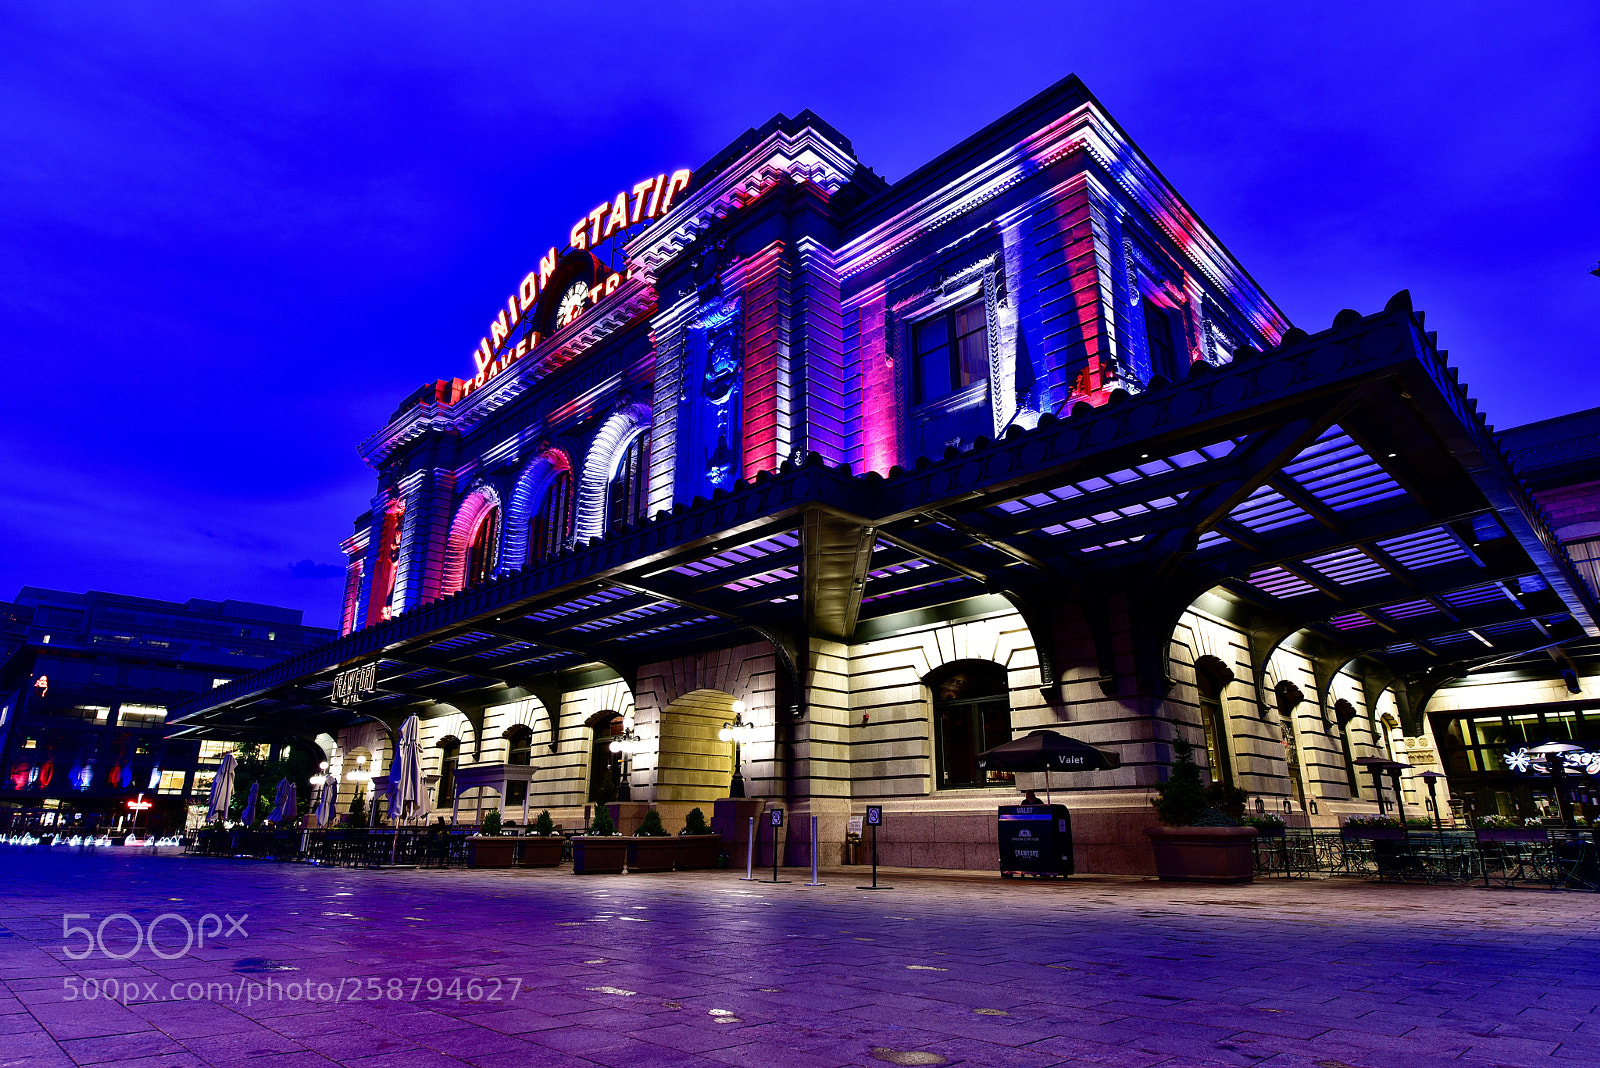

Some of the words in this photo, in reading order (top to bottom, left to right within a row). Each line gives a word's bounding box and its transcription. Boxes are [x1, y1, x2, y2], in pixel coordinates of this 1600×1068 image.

[473, 247, 558, 373] UNION
[485, 404, 538, 448] UNION
[549, 351, 623, 412] STATION
[331, 662, 376, 703] CRAWFORD
[1058, 755, 1084, 764] Valet
